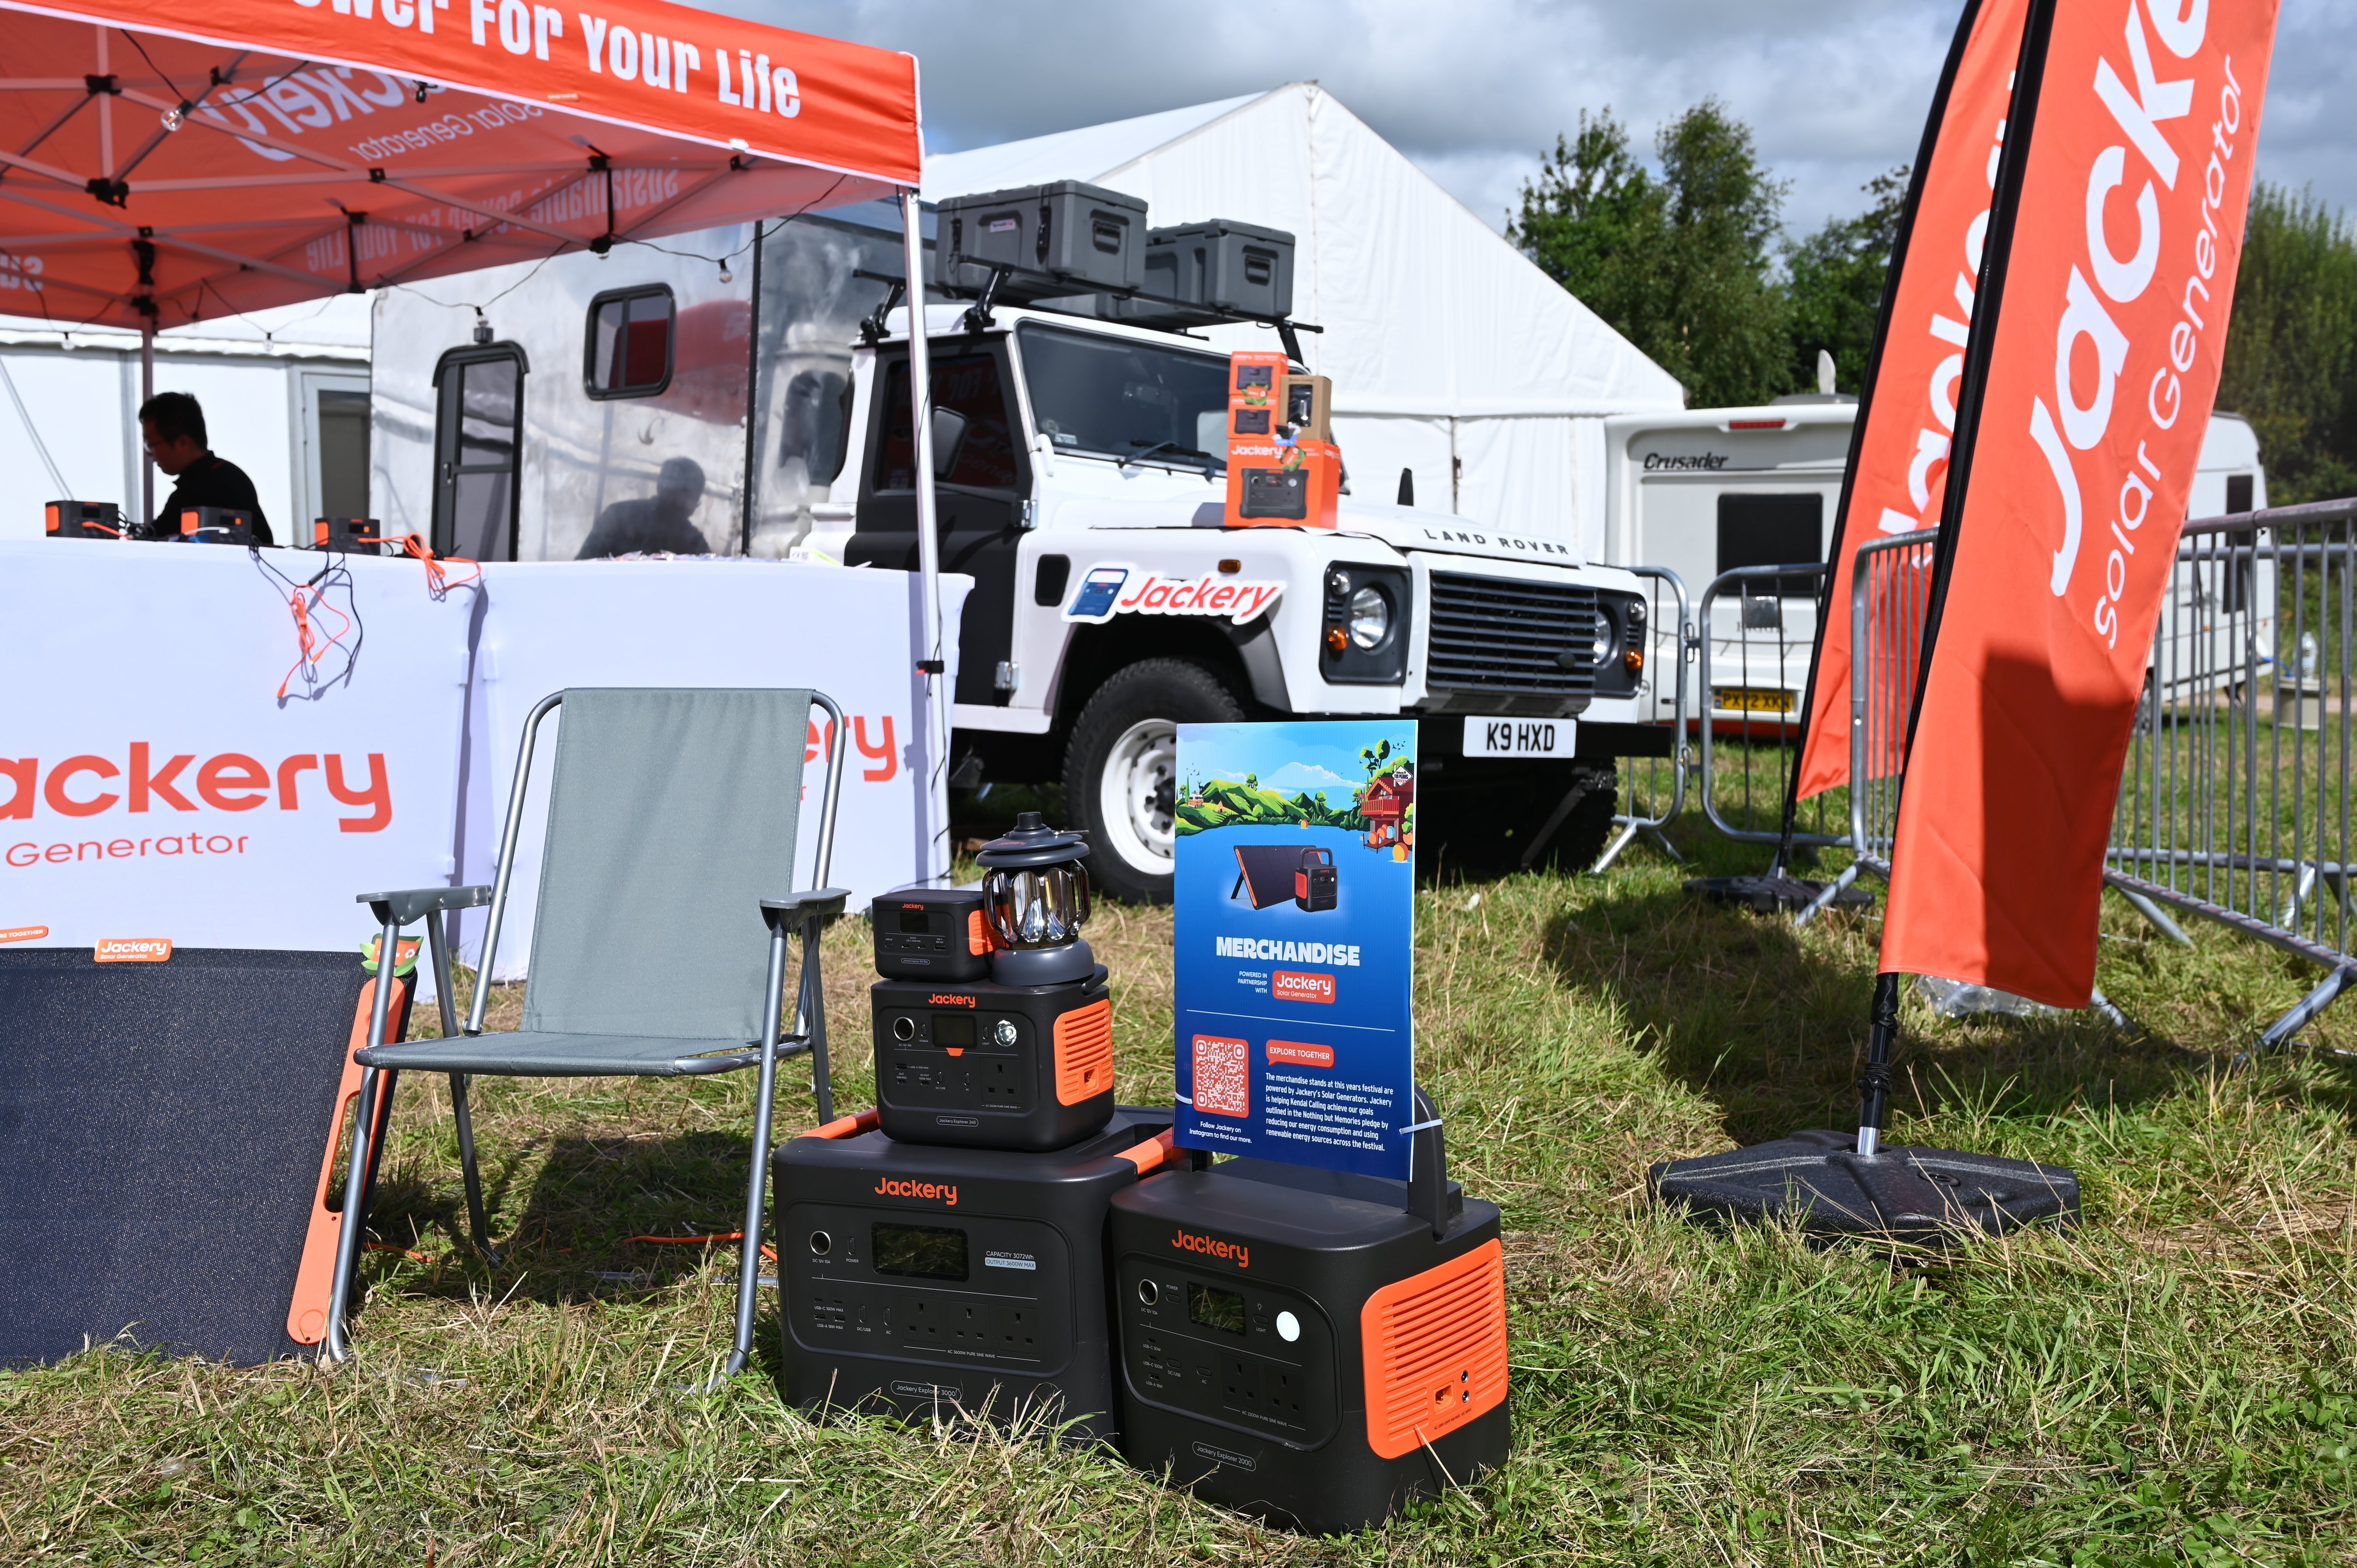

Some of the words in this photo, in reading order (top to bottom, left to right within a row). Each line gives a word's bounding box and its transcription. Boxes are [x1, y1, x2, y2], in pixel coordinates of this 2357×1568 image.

[470, 0, 563, 61] For
[579, 12, 701, 93] Your
[715, 48, 801, 118] Life
[2094, 440, 2160, 649] Solar
[2148, 54, 2244, 430] Generator
[1231, 445, 1283, 459] Jackery
[1644, 451, 1729, 469] Crusader
[1424, 529, 1486, 544] LAND
[1498, 537, 1568, 555] ROVER
[1121, 577, 1278, 618] Jackery
[1723, 693, 1759, 708] PX2
[1487, 723, 1512, 751] K9
[1518, 724, 1555, 752] HXD
[5, 832, 249, 867] Generator
[9, 929, 44, 938] TOGETHER
[101, 941, 167, 955] Jackery
[1216, 936, 1360, 966] MERCHANDISE
[1276, 975, 1331, 995] Jackery
[929, 993, 975, 1008] Jackery
[1270, 1047, 1296, 1056] EXPLORE
[1297, 1050, 1330, 1060] TOGETHER
[1276, 1075, 1308, 1084] merchandise
[1309, 1078, 1327, 1087] stands
[1334, 1080, 1345, 1089] this
[1346, 1083, 1361, 1091] years
[1362, 1084, 1383, 1093] festival
[1266, 1085, 1287, 1093] powered
[1288, 1086, 1295, 1096] by
[1295, 1088, 1320, 1098] Jackery's
[1322, 1090, 1335, 1099] Solar
[1336, 1092, 1368, 1104] Generators.
[1369, 1097, 1392, 1108] Jackery
[1271, 1095, 1289, 1106] helping
[1291, 1098, 1307, 1107] Kendal
[1309, 1100, 1326, 1111] Calling
[1327, 1103, 1347, 1112] achieve
[1359, 1107, 1374, 1116] goals
[1216, 1124, 1234, 1133] Jackery
[1266, 1107, 1286, 1115] outlined
[1303, 1111, 1323, 1122] Nothing
[1324, 1113, 1333, 1122] but
[1335, 1114, 1360, 1125] Memories
[1362, 1118, 1380, 1129] pledge
[1382, 1120, 1388, 1130] by
[1189, 1128, 1213, 1137] Instagram
[1266, 1118, 1288, 1128] reducing
[1299, 1123, 1316, 1132] energy
[1318, 1125, 1351, 1135] consumption
[1364, 1130, 1378, 1141] using
[1266, 1129, 1292, 1138] renewable
[1293, 1133, 1310, 1142] energy
[1312, 1135, 1332, 1144] sources
[1333, 1138, 1351, 1147] across
[1352, 1139, 1361, 1148] the
[1362, 1141, 1385, 1151] festival.
[875, 1178, 958, 1205] Jackery
[1171, 1230, 1248, 1268] Jackery
[896, 1384, 917, 1393] Jackery
[918, 1386, 940, 1395] Explorr
[1197, 1445, 1216, 1457] Jackery
[1217, 1451, 1237, 1462] Explorer
[1238, 1457, 1252, 1466] 2000
